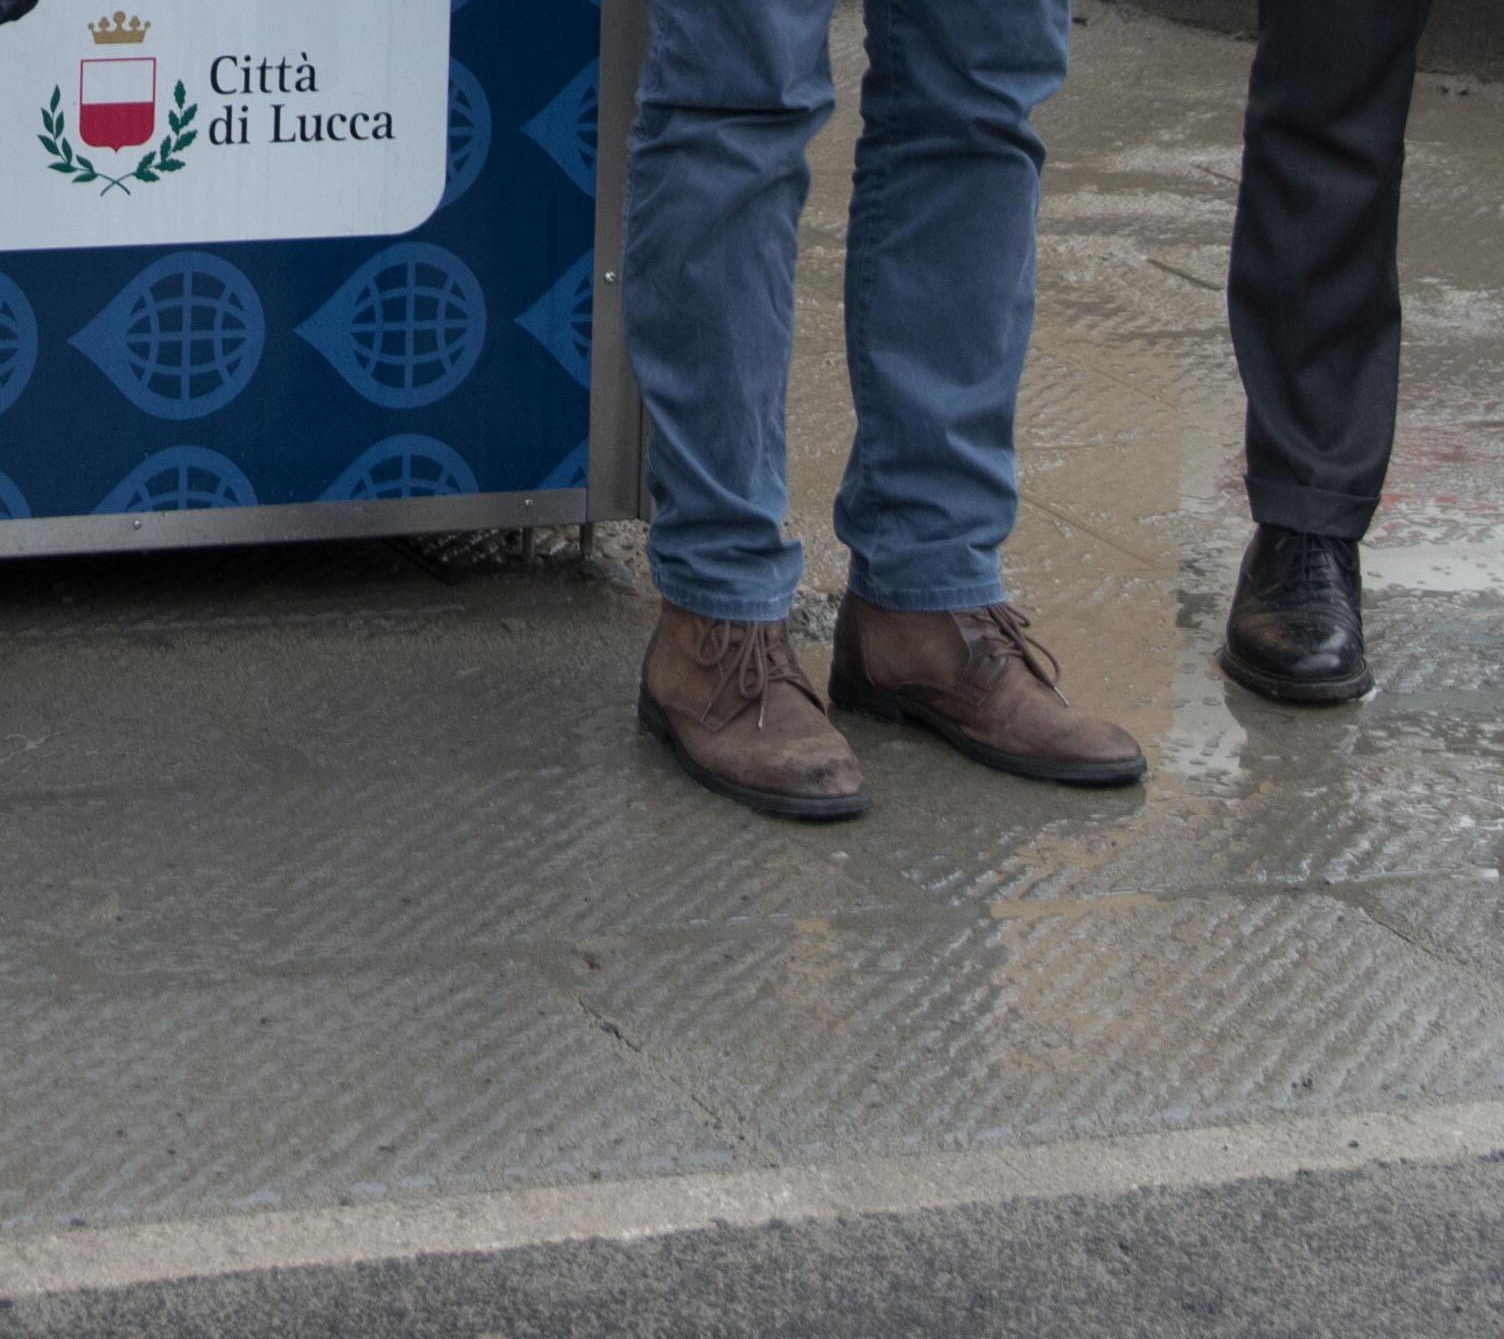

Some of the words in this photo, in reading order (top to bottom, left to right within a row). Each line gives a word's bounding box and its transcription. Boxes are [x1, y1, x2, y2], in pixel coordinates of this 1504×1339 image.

[209, 51, 320, 96] Città
[208, 104, 251, 146] di
[268, 103, 396, 143] Lucca
